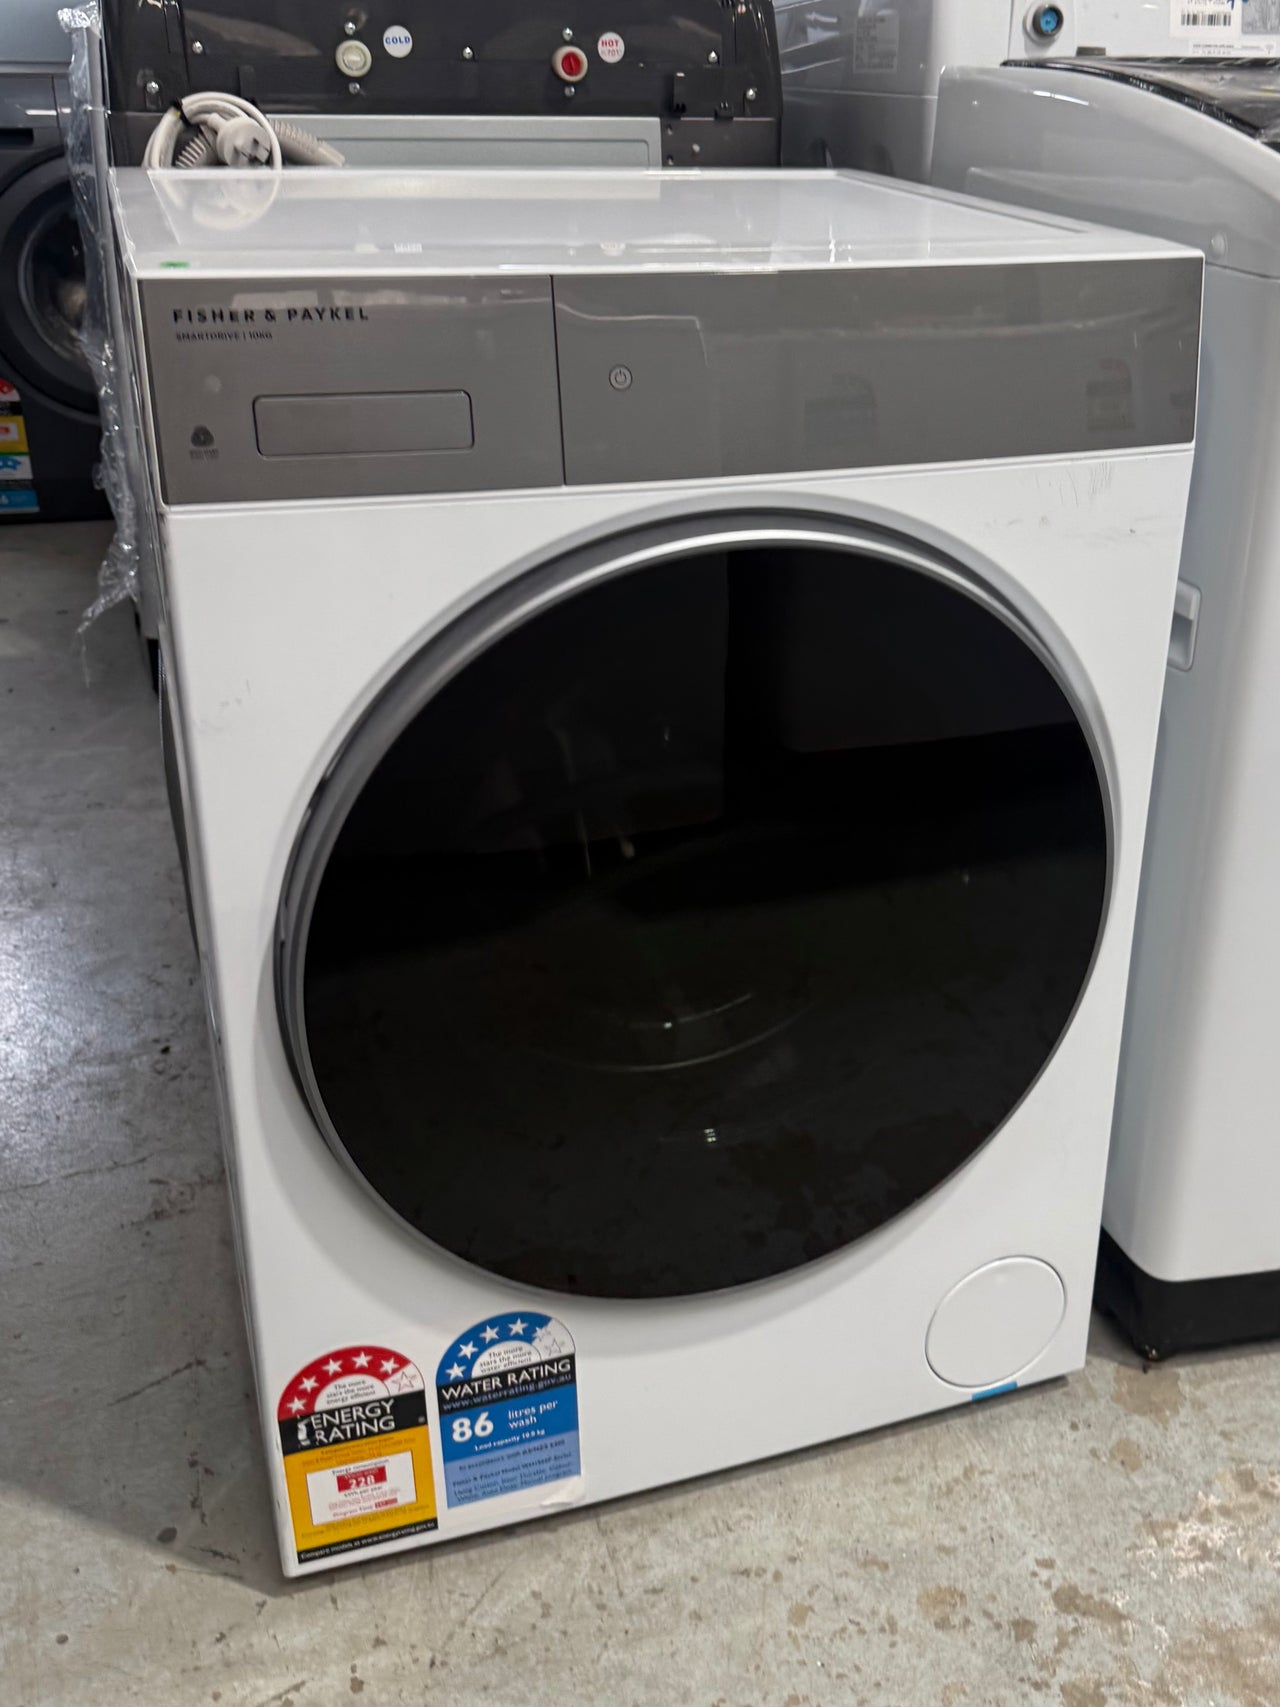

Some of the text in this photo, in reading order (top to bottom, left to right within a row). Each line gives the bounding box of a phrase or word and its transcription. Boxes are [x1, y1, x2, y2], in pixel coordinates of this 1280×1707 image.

[385, 36, 410, 45] COLD
[601, 39, 619, 48] HOT
[173, 306, 369, 324] FISHER & PAYKEL
[176, 331, 238, 342] SMARTDRIVE
[480, 1351, 532, 1369] stars the more
[488, 1346, 523, 1359] The more
[480, 1357, 532, 1374] water efficient
[334, 1379, 366, 1390] The more
[441, 1359, 571, 1401] WATER RATING
[326, 1384, 375, 1399] stars the more
[327, 1390, 376, 1405] energy efficient
[443, 1373, 572, 1411] www.waterrating.gov.au
[311, 1398, 395, 1429] ENERGY
[452, 1401, 558, 1443] 86 litres per
[508, 1415, 537, 1429] wash
[315, 1415, 396, 1446] RATING
[474, 1441, 492, 1452] Load
[493, 1435, 520, 1448] capacity
